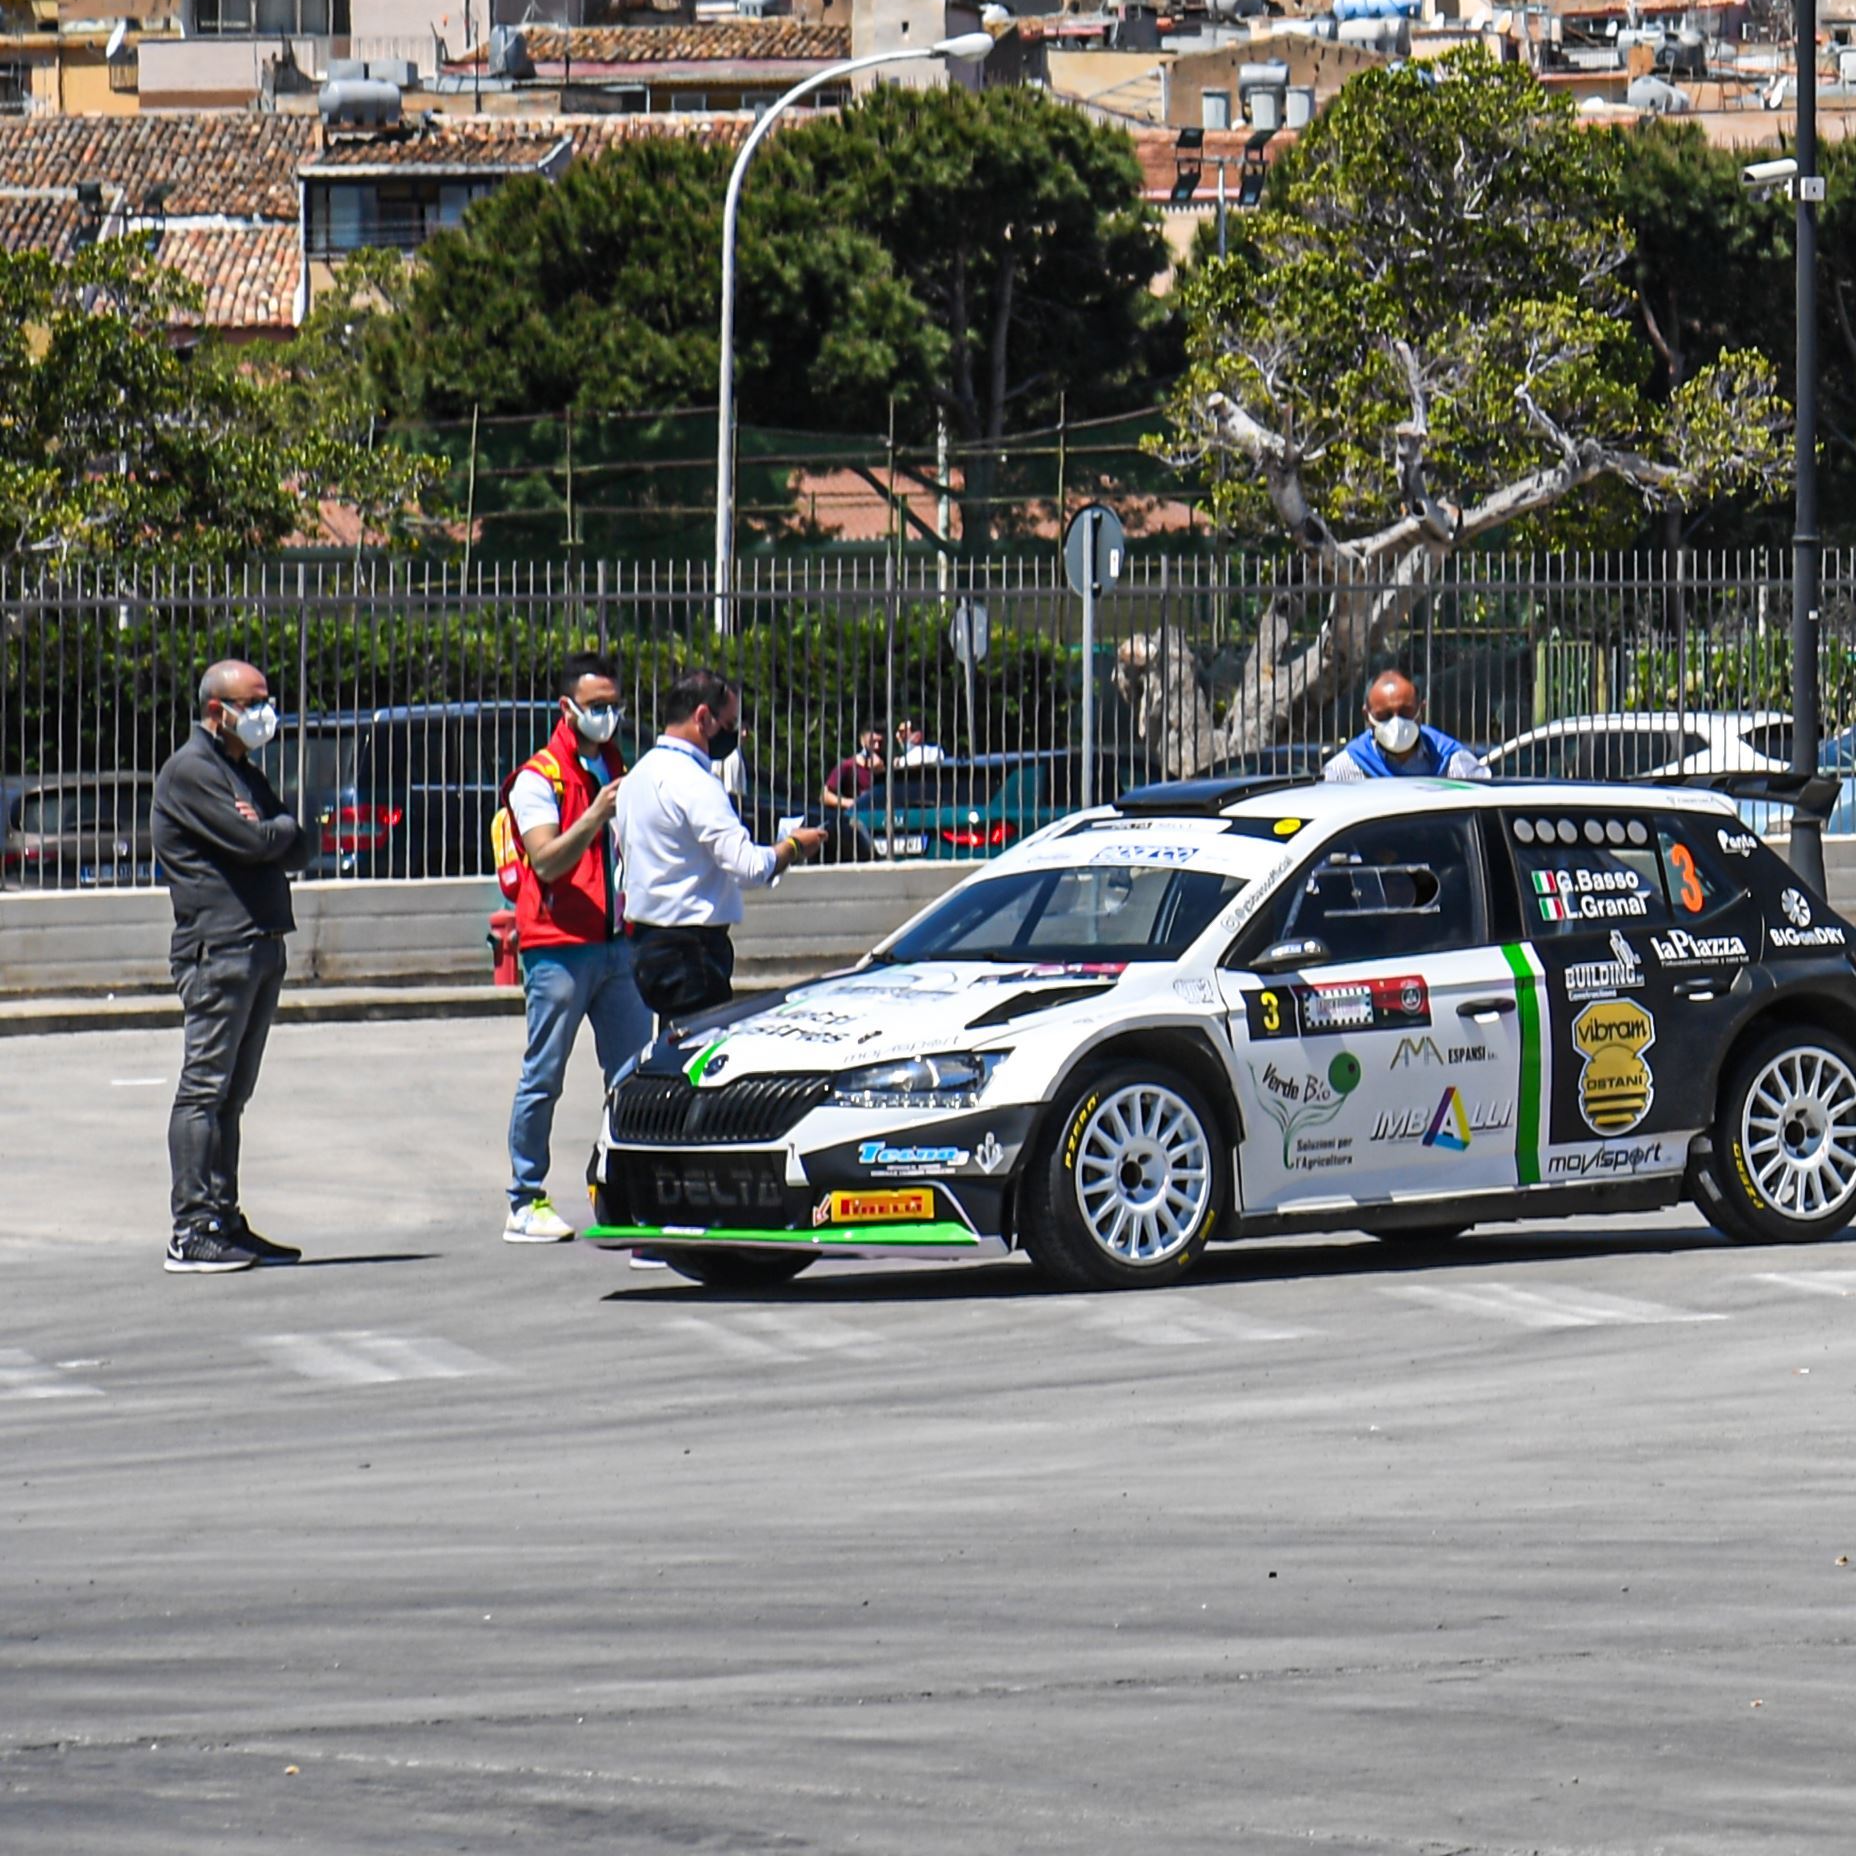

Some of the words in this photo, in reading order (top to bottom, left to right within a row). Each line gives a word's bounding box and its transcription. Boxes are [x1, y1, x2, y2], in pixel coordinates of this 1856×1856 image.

[1556, 869, 1639, 892] G.Basso
[1670, 843, 1704, 913] 3
[1564, 963, 1637, 990] BUILDING
[1260, 990, 1281, 1030] 3
[1577, 1015, 1650, 1043] vibram
[1448, 1045, 1487, 1065] ESPANSI
[1261, 1061, 1300, 1101] Verde
[1304, 1073, 1331, 1104] Bio
[1370, 1086, 1513, 1152] IMBALLI
[1296, 1138, 1336, 1153] Soluzioni
[1337, 1136, 1354, 1151] per
[655, 1167, 784, 1207] DELTA
